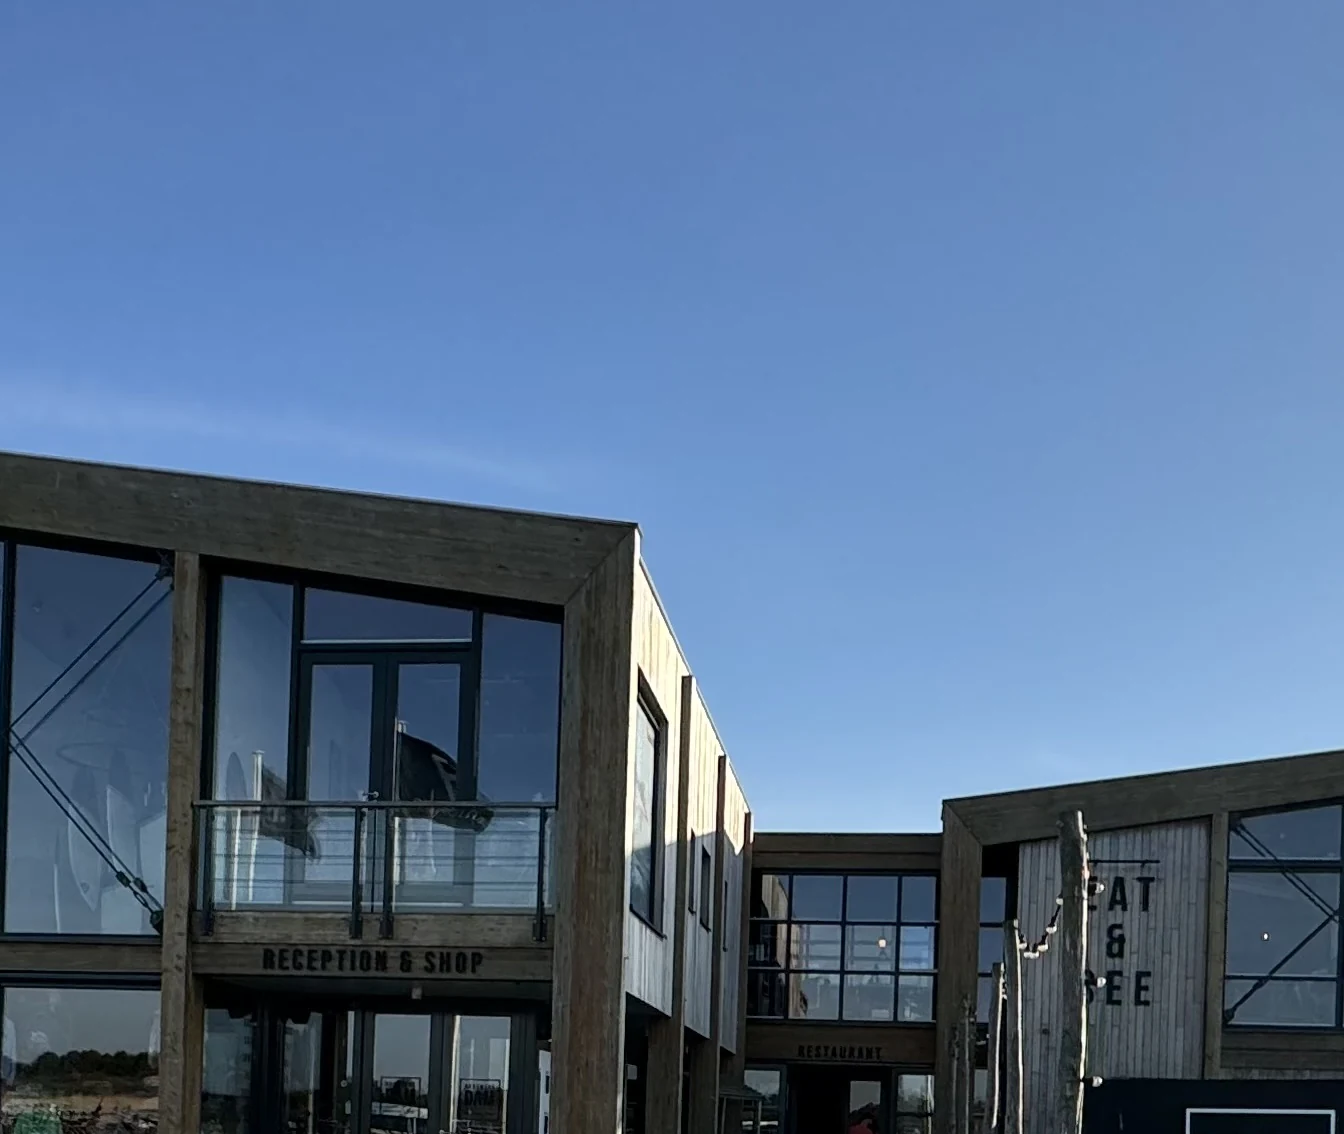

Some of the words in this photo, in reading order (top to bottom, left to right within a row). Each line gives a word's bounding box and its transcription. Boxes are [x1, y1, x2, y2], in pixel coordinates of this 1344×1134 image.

[1107, 923, 1126, 959] &
[262, 948, 388, 973] RECEPTION
[399, 951, 413, 973] &
[423, 951, 484, 974] SHOP
[798, 1045, 883, 1060] RESTAURANT
